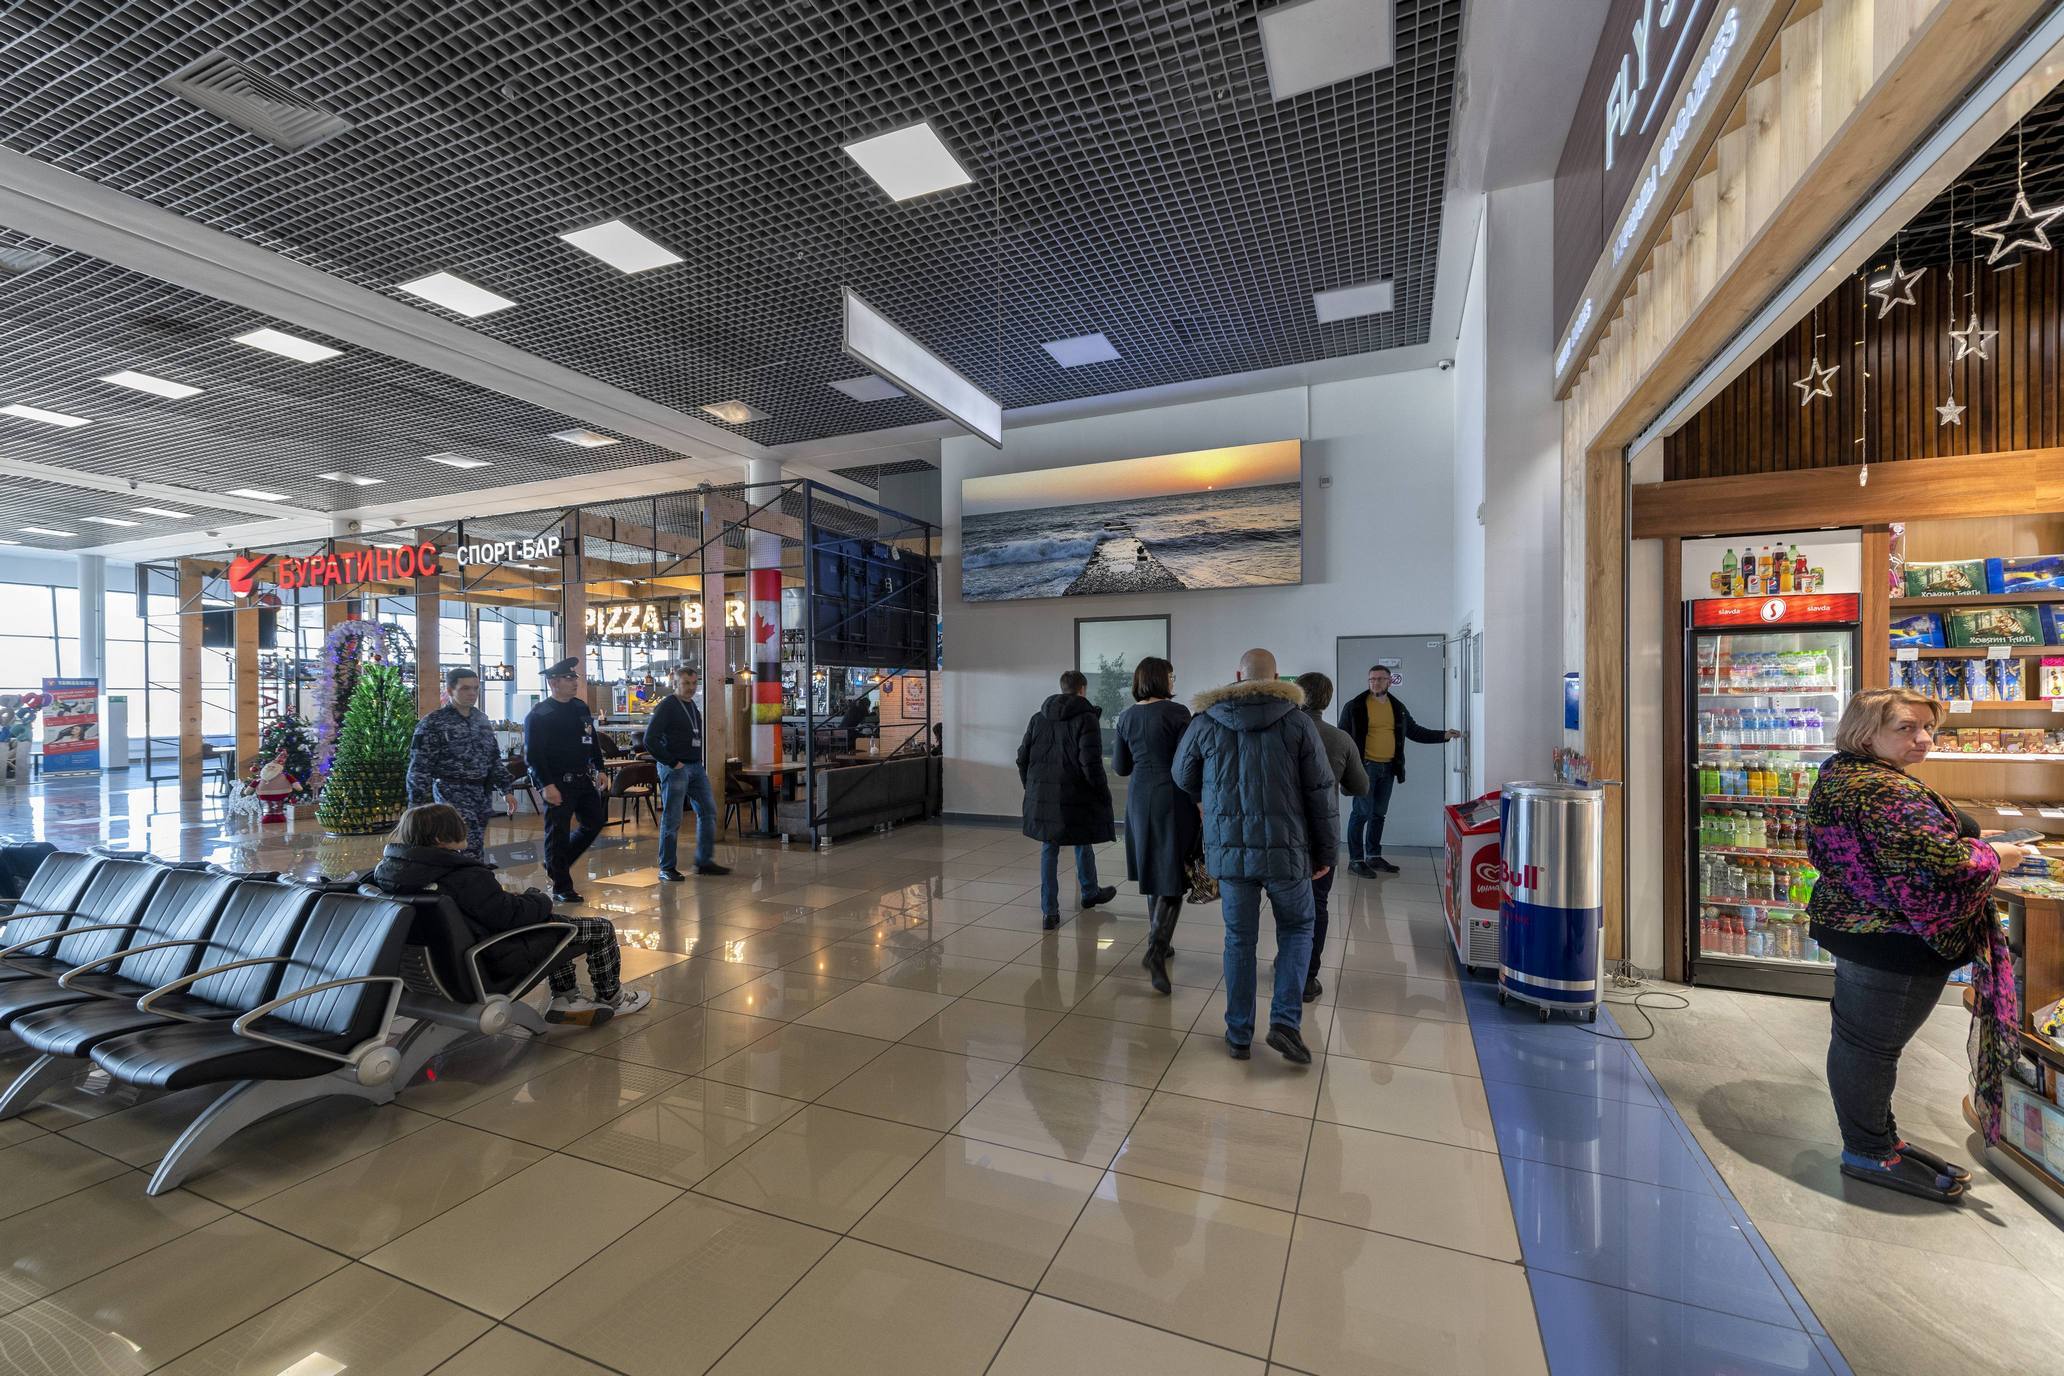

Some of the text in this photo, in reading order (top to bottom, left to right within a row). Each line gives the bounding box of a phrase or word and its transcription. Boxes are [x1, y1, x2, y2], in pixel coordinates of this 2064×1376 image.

[279, 541, 437, 589] БУРАТИНОС
[457, 537, 559, 565] СПОРТ-БАР
[585, 600, 746, 635] PIZZA BR
[1807, 604, 1831, 612] slavda
[1501, 860, 1538, 890] Bull
